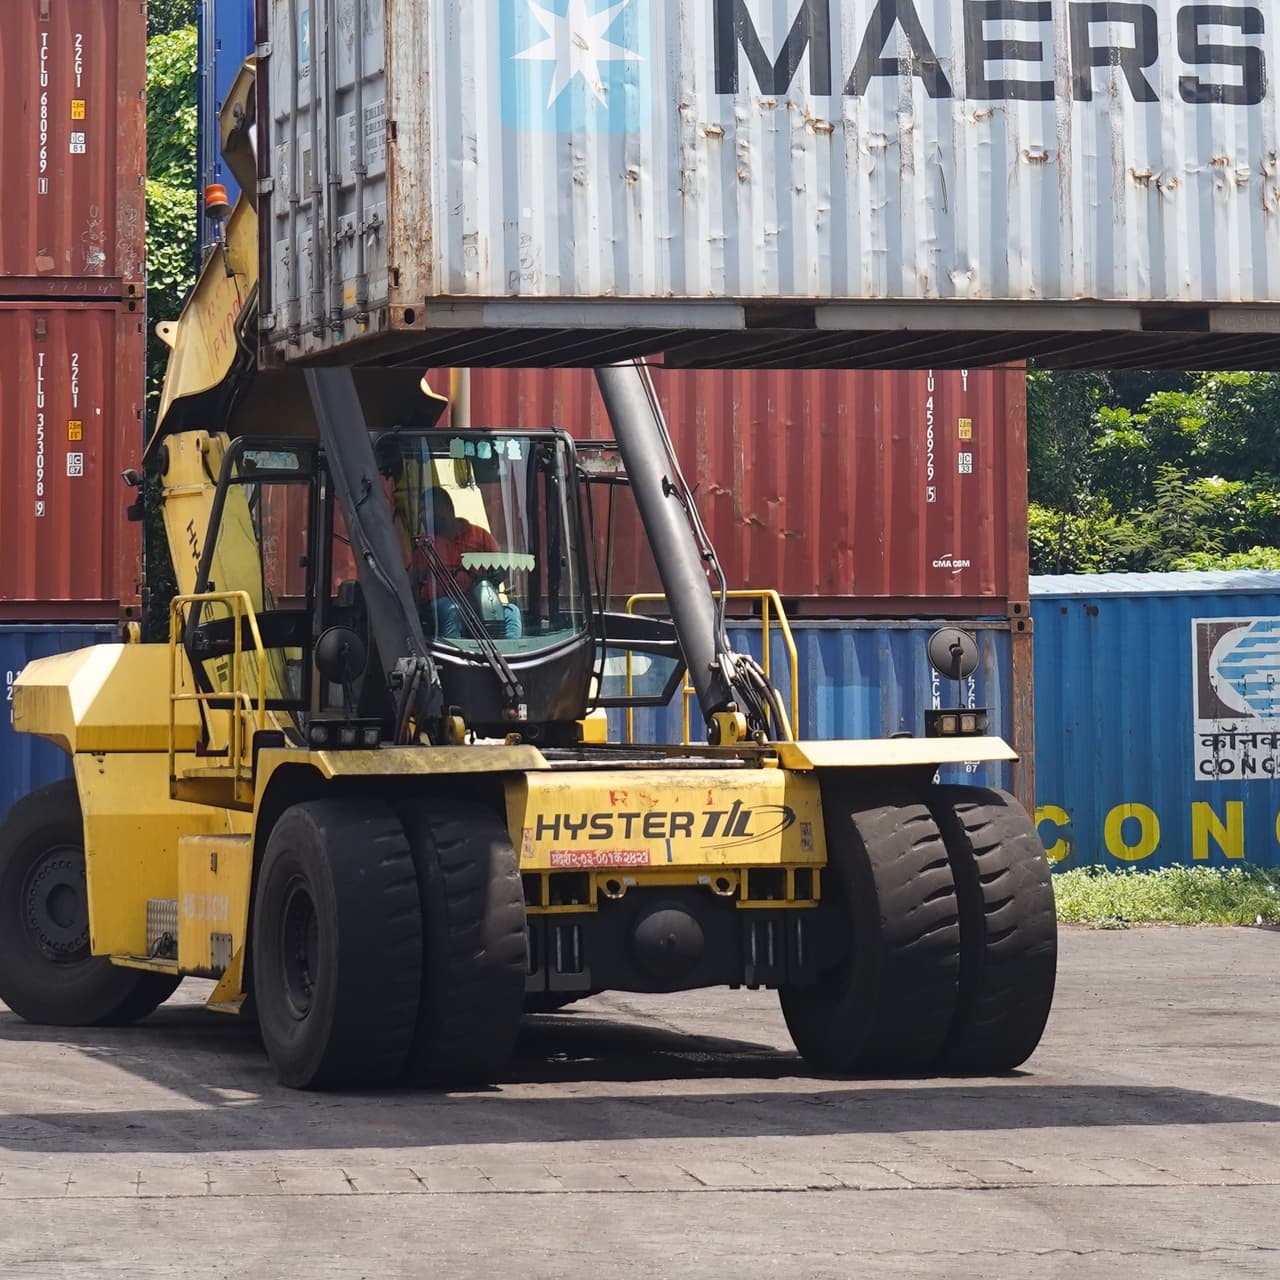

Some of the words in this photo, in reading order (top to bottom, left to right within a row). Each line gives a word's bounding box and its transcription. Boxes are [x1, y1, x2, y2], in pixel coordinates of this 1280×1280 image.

[40, 32, 49, 88] TCLU
[74, 33, 83, 88] 22G1
[38, 91, 48, 173] 680969
[37, 352, 45, 409] TLLU
[71, 352, 79, 408] 22G1
[36, 413, 45, 496] 353098
[926, 396, 935, 481] 456929
[535, 810, 695, 841] HYSTER
